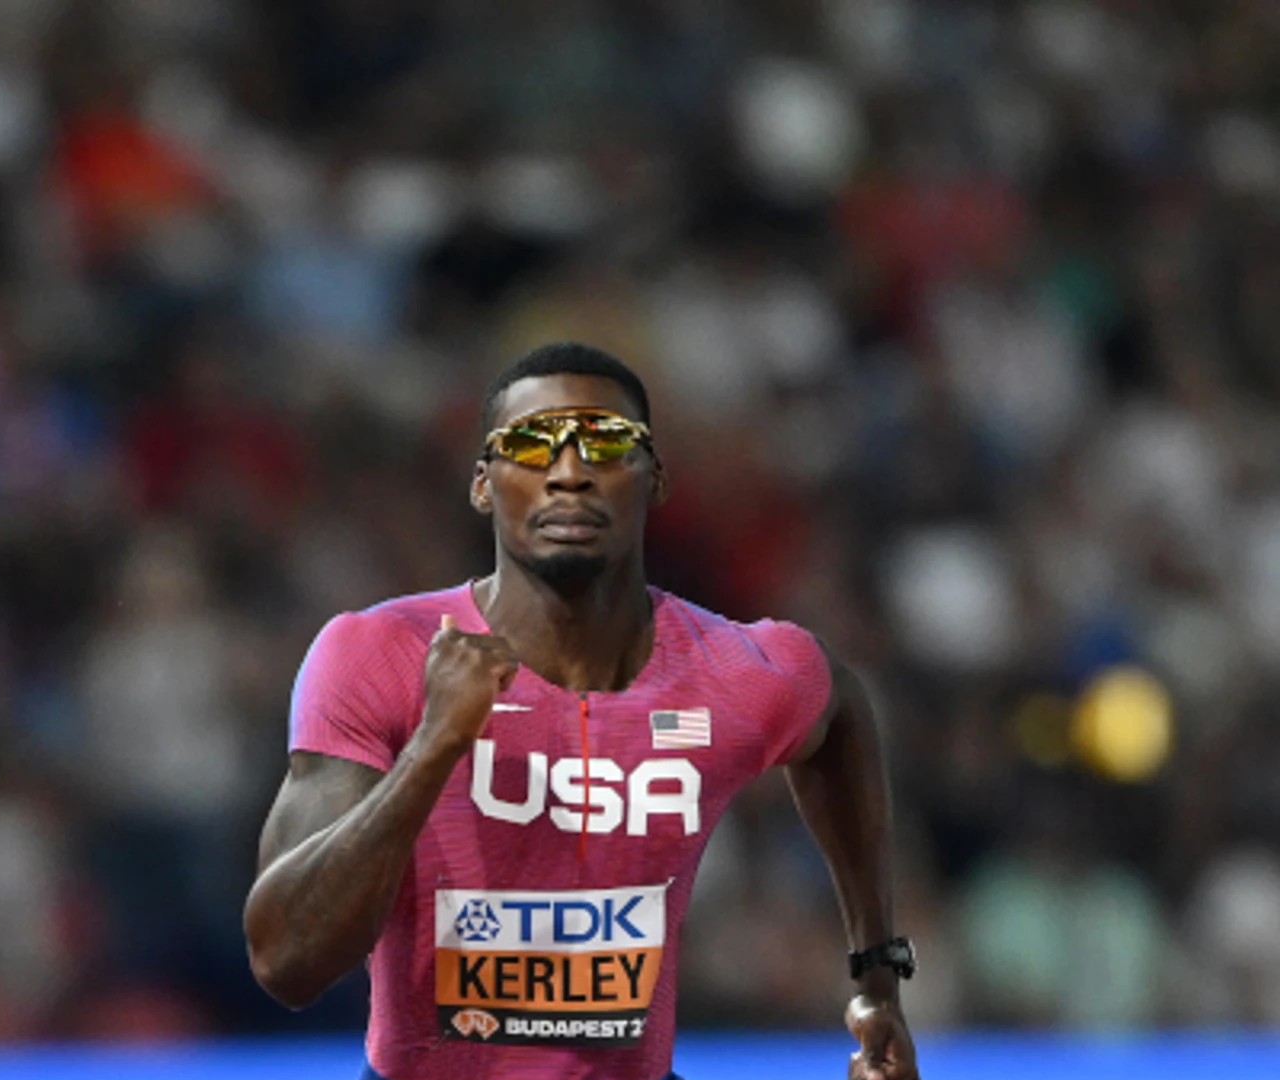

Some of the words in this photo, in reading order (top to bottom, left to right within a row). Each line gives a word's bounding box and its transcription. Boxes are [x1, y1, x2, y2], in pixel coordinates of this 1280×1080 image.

[470, 739, 702, 836] USA
[501, 896, 646, 943] TDK
[458, 953, 647, 1003] KERLEY
[505, 1017, 628, 1038] BUDAPEST
